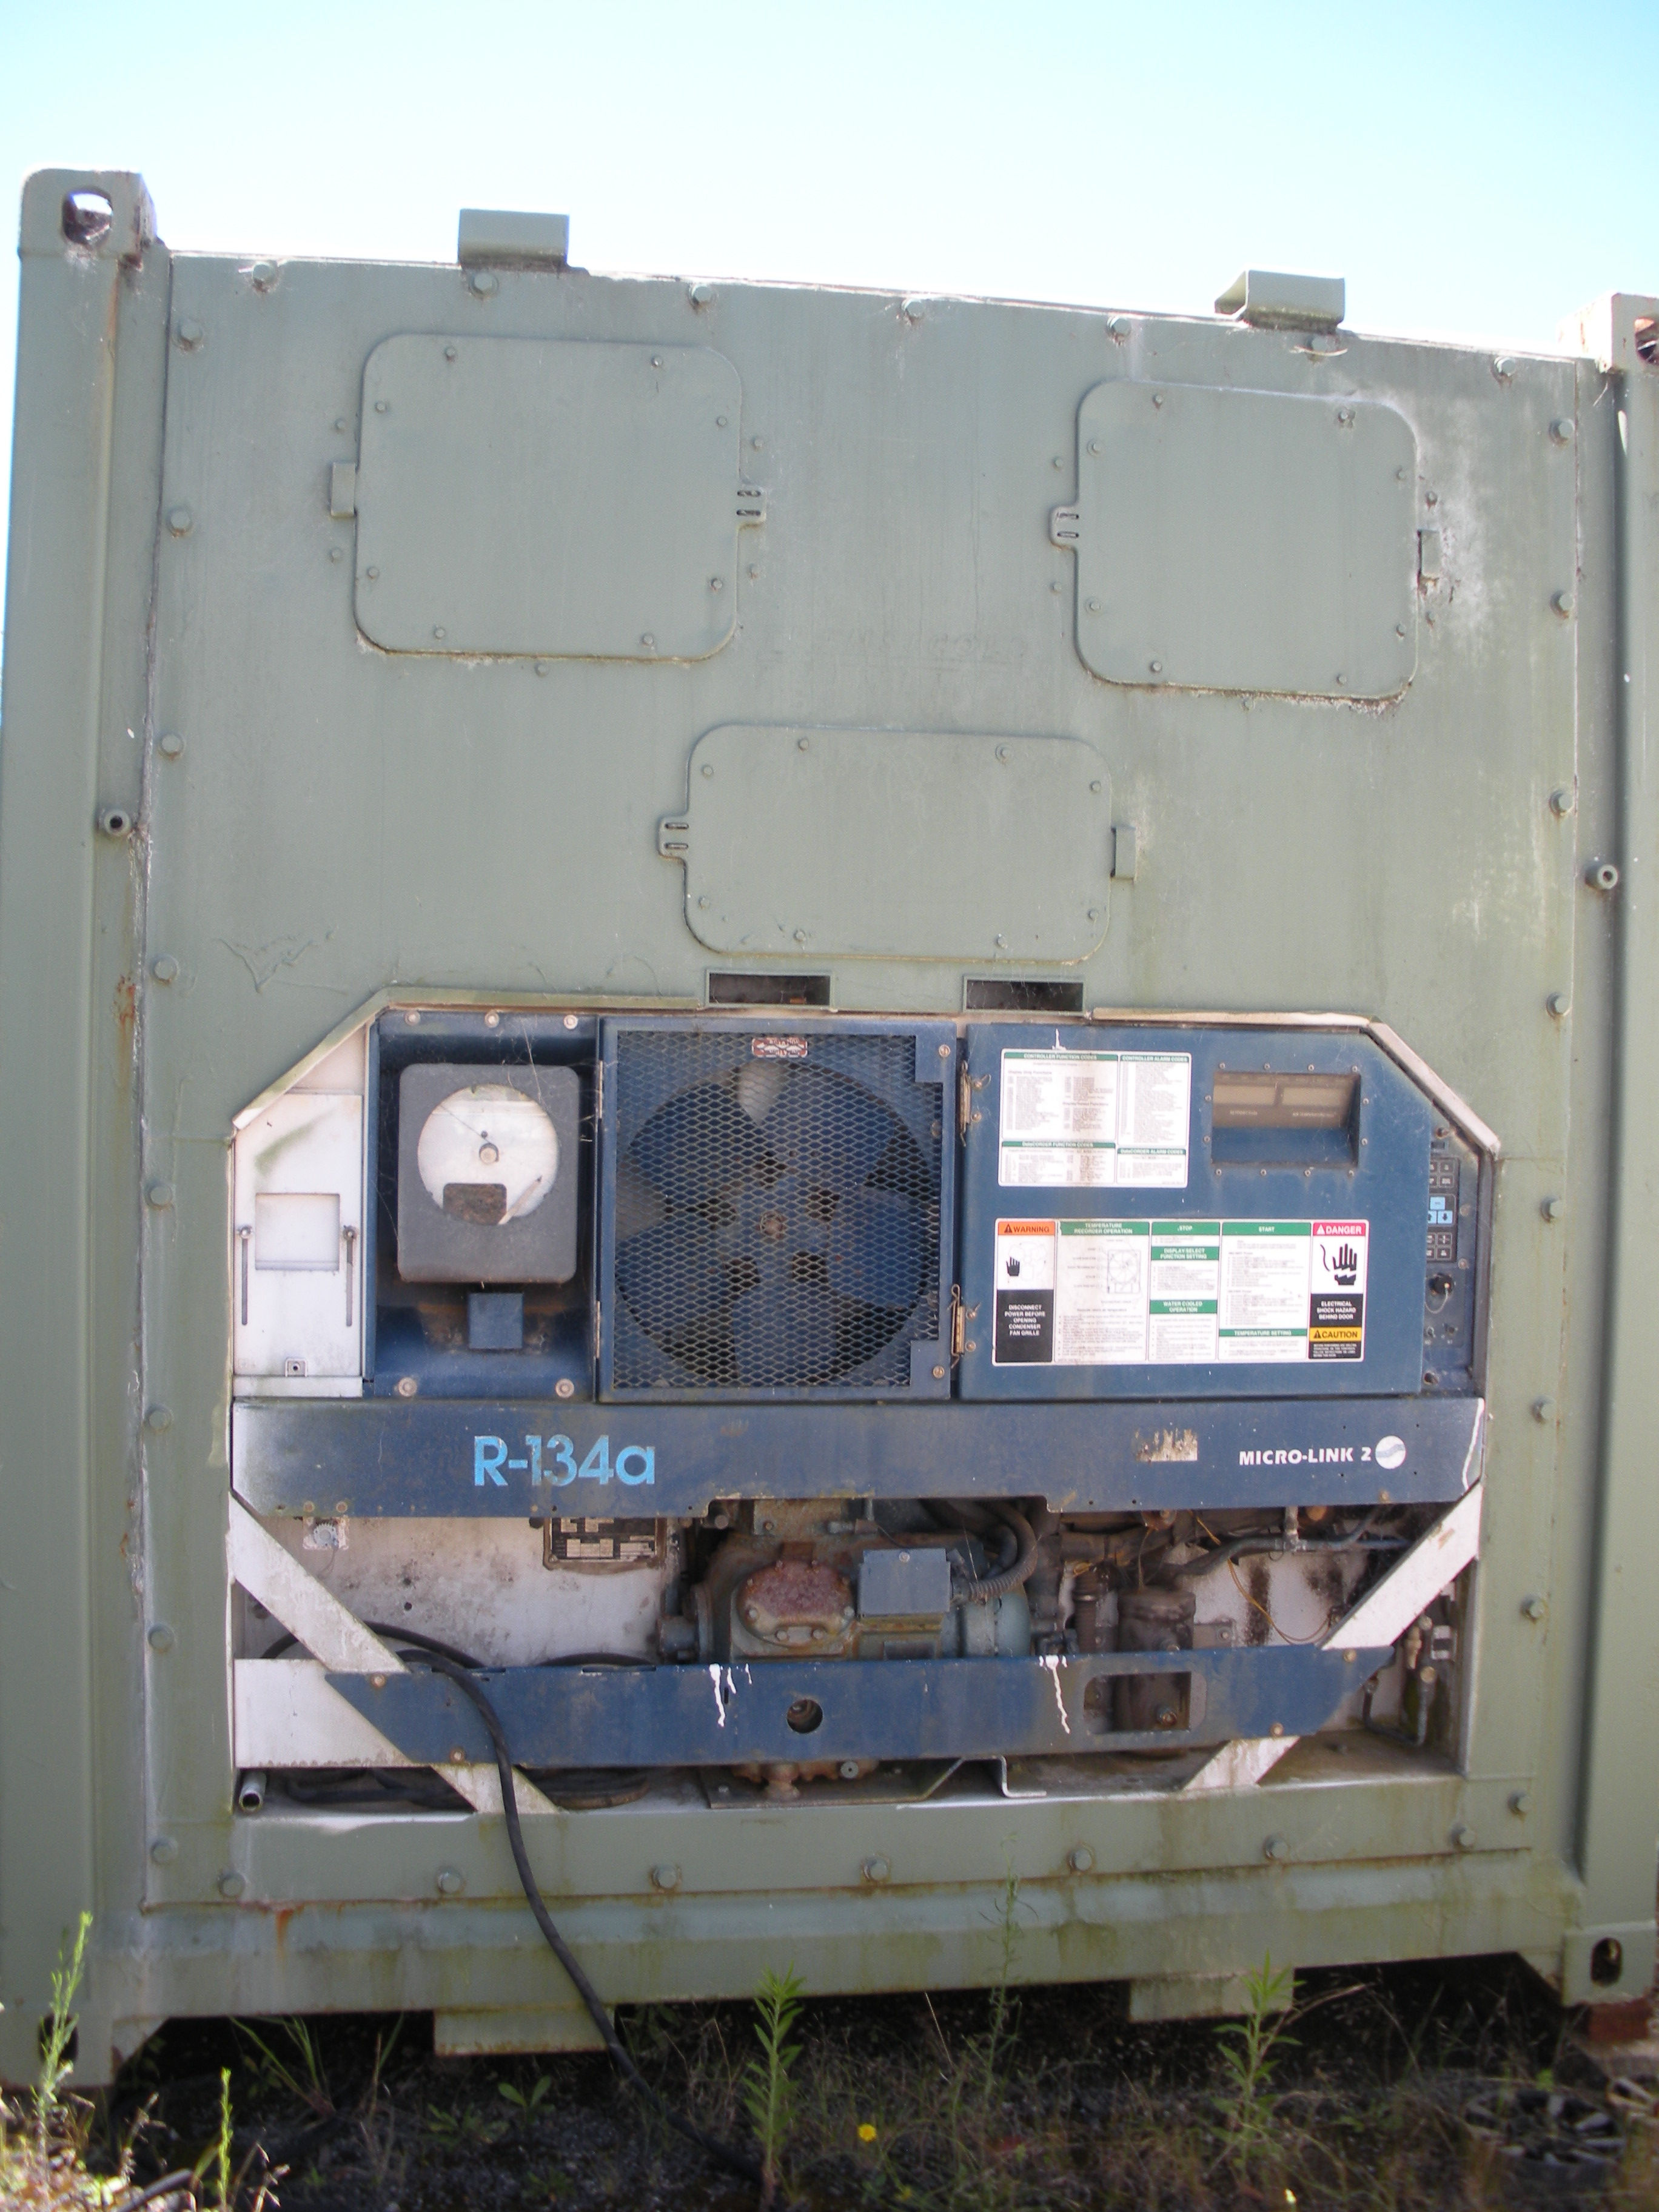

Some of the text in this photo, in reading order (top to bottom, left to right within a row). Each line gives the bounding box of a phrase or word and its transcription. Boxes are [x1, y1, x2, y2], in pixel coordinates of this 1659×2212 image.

[1326, 1225, 1362, 1235] DANGER
[474, 1433, 655, 1487] R-134a
[1239, 1447, 1372, 1466] MICRO-LINK 2
